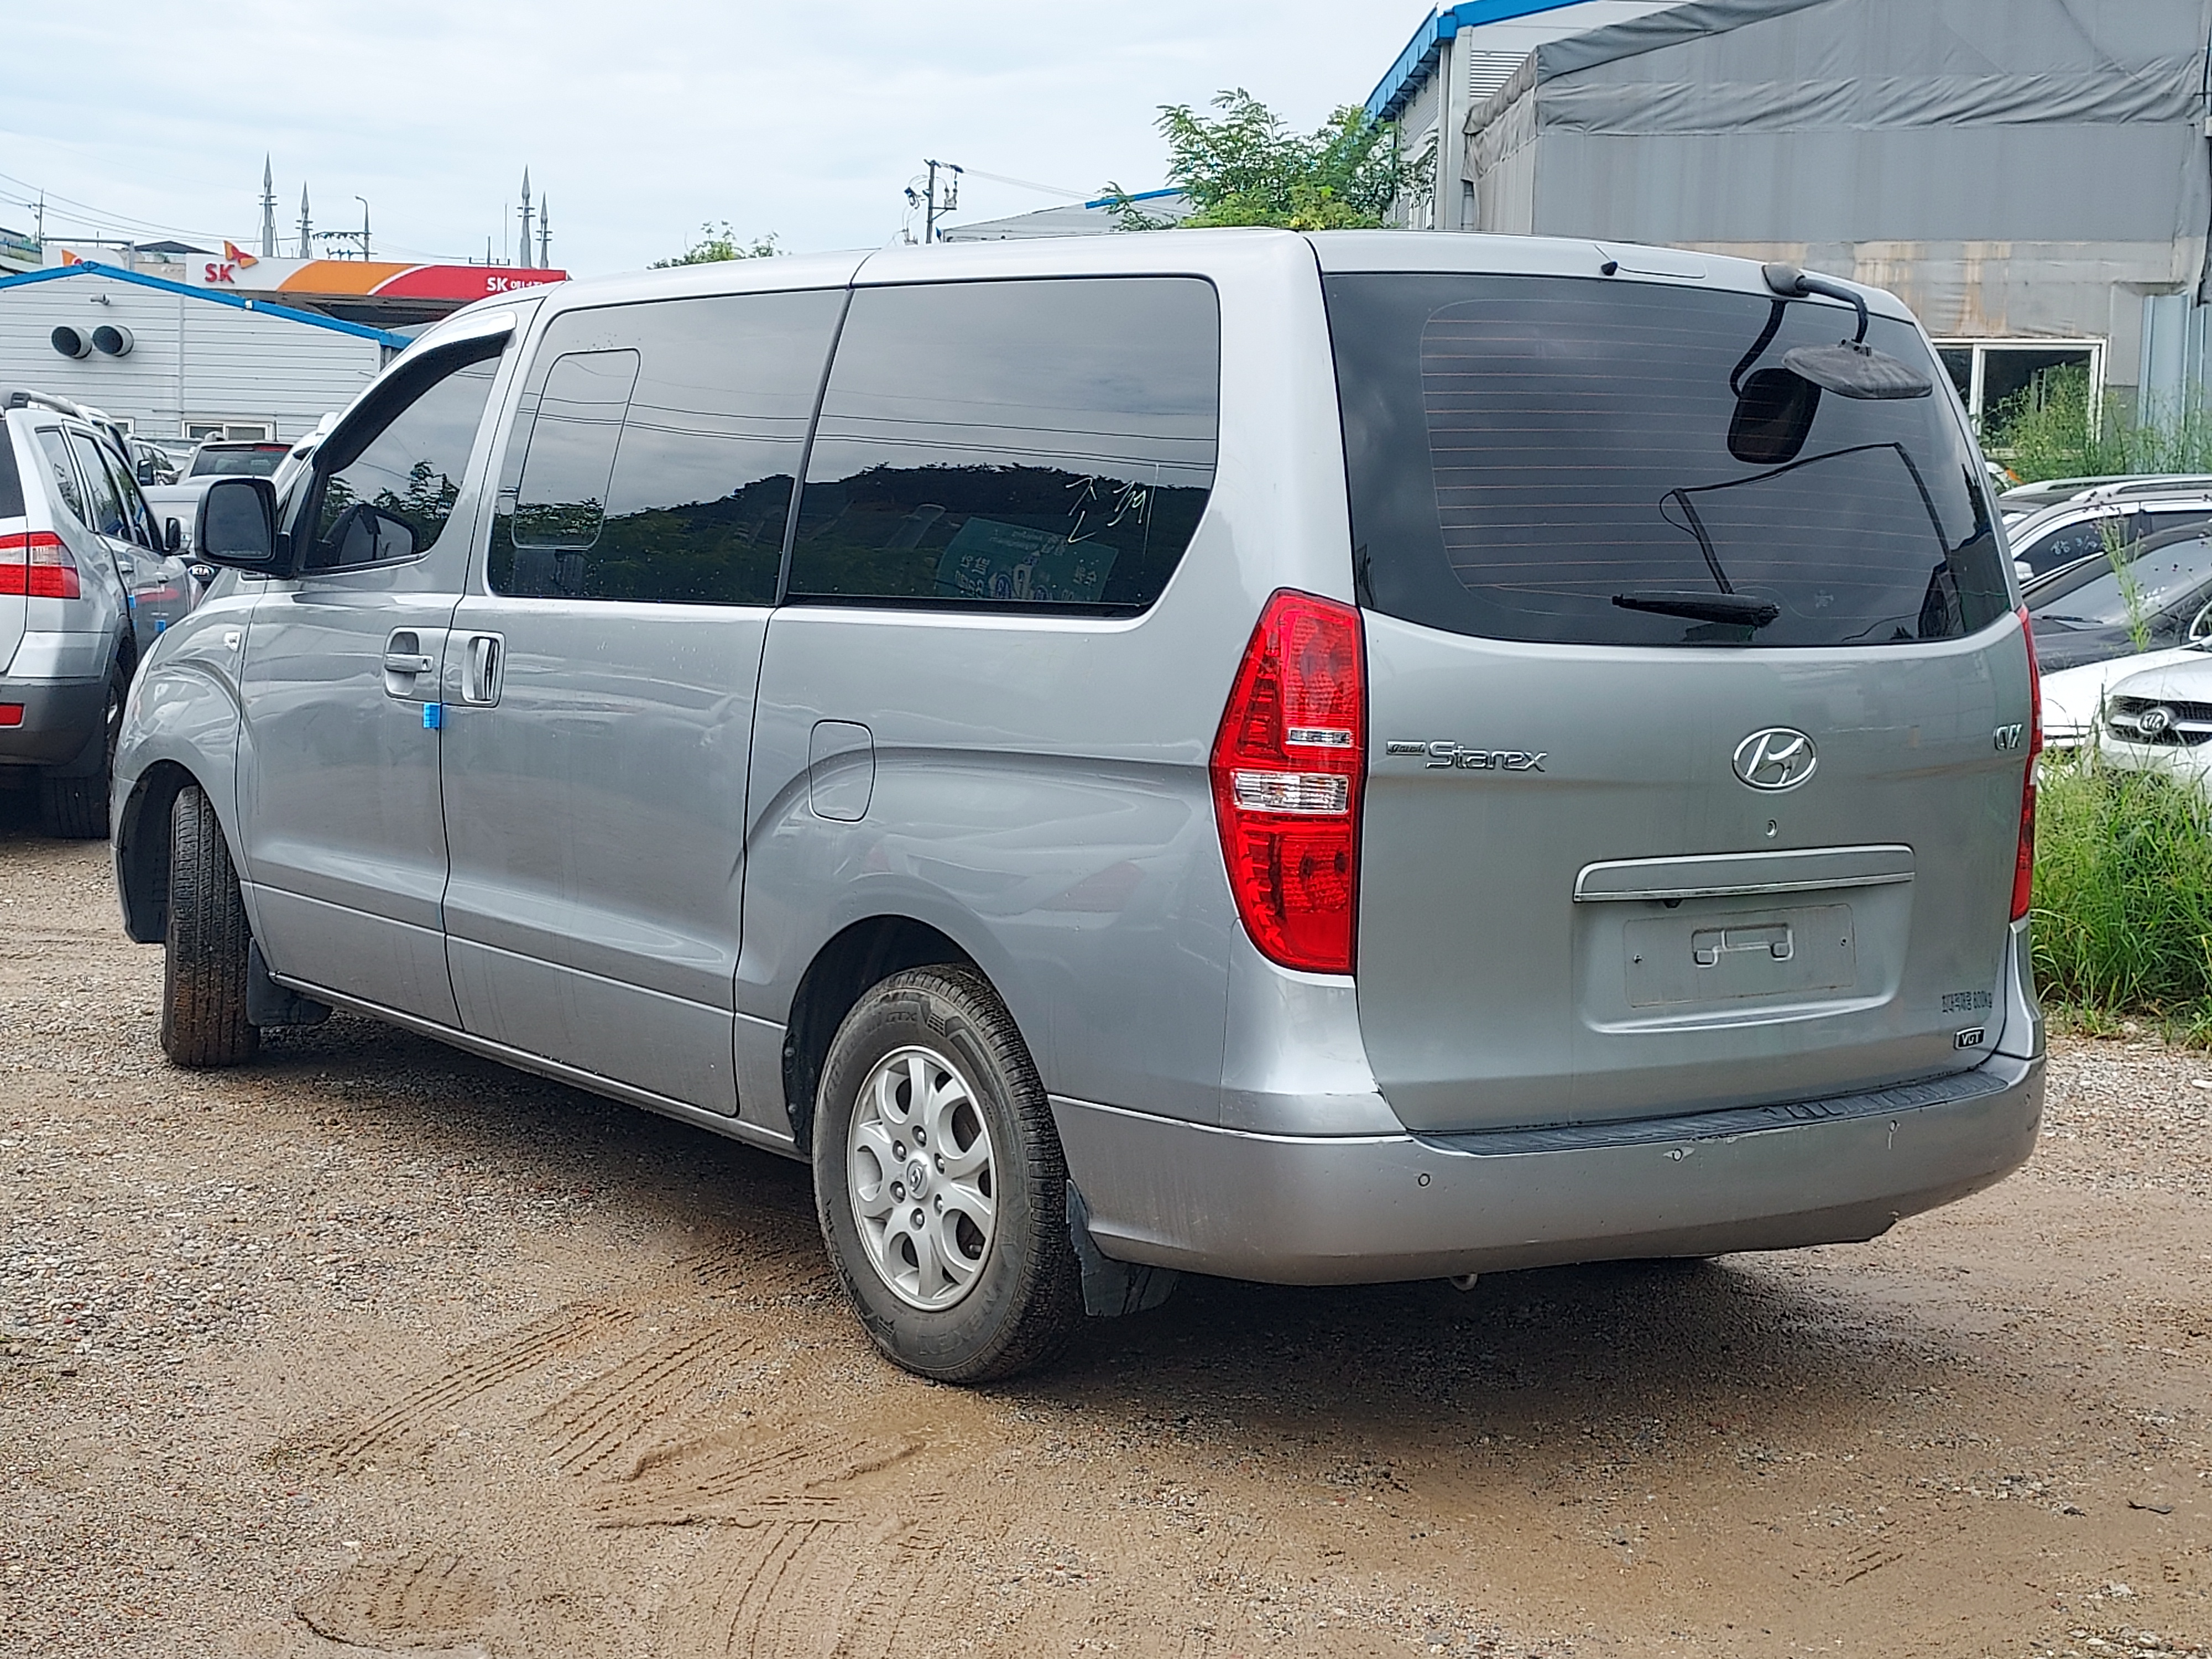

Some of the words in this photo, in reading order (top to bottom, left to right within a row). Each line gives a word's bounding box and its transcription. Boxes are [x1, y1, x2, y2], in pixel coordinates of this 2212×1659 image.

[205, 263, 235, 284] SK
[486, 276, 508, 291] SK
[1426, 740, 1547, 772] Starex
[1962, 1031, 1981, 1045] VGT
